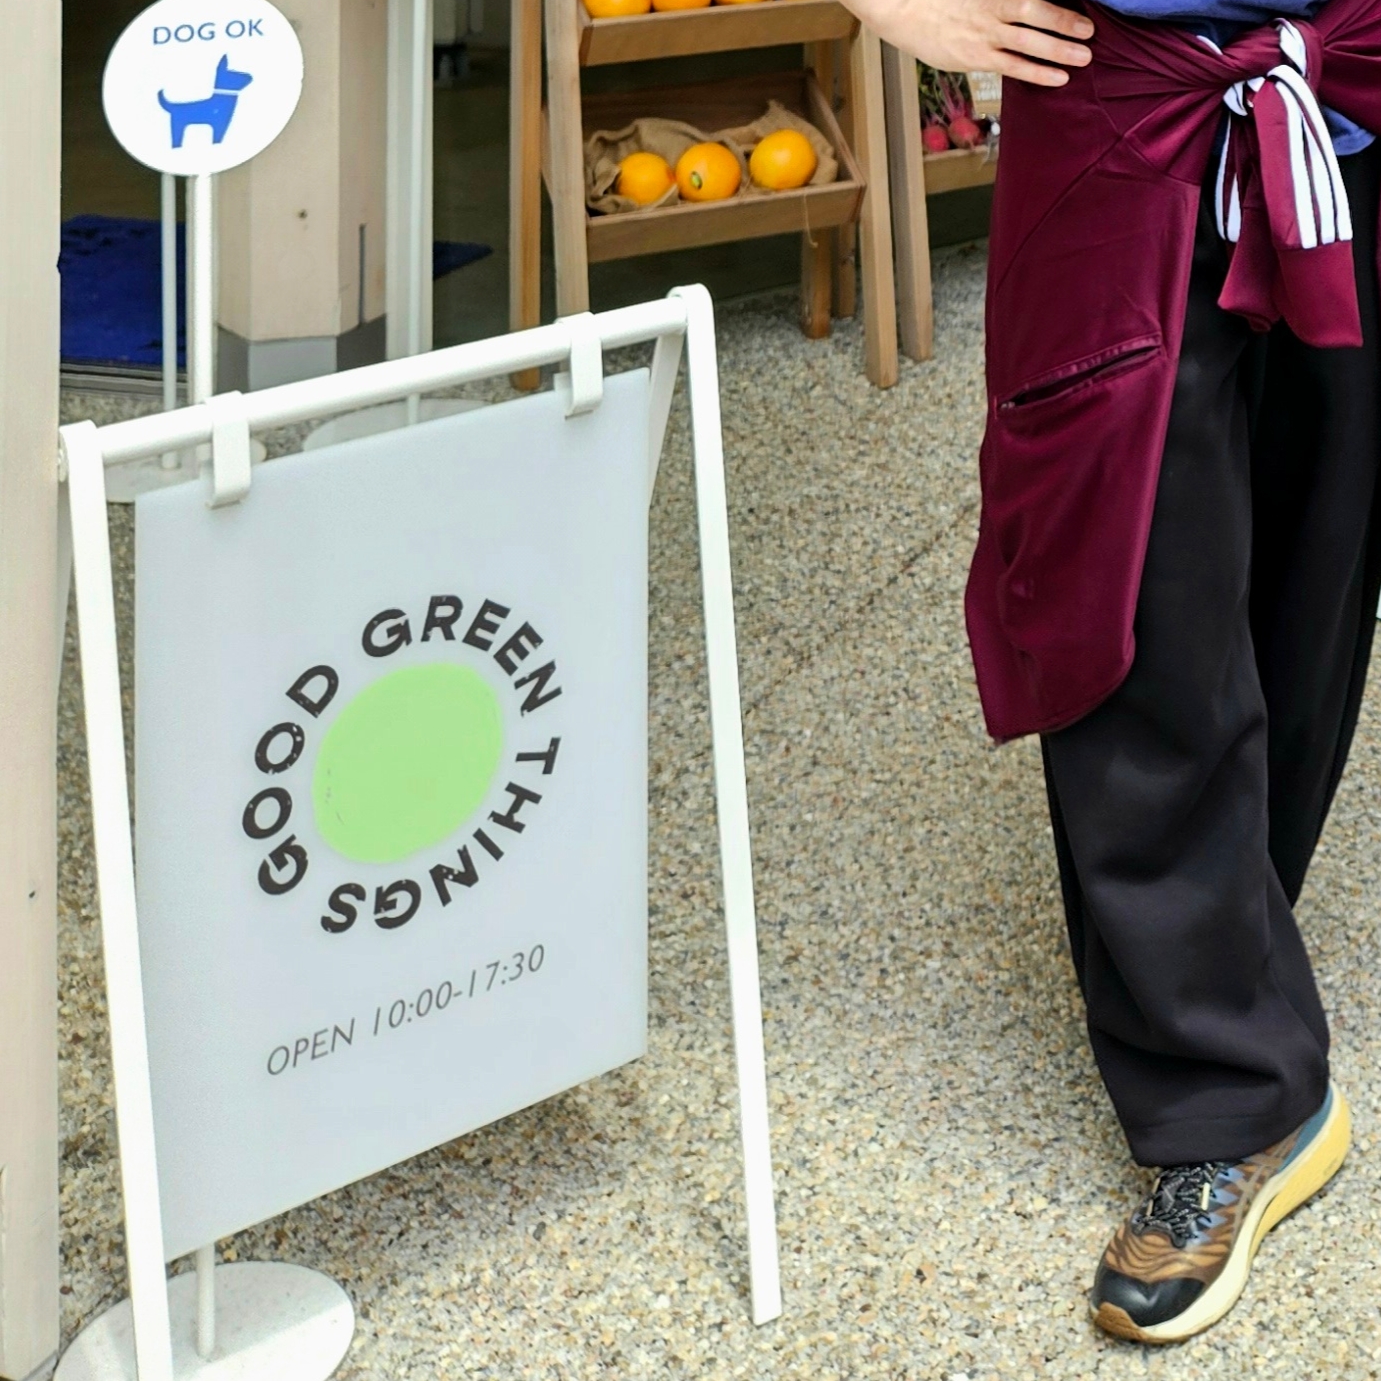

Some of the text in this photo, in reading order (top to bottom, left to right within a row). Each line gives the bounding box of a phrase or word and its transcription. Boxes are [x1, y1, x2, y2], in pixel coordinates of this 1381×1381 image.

[152, 19, 264, 46] DOG OK
[241, 594, 563, 934] GOOD GREEN THINGS
[266, 944, 546, 1076] OPEN 10:00-17:30
